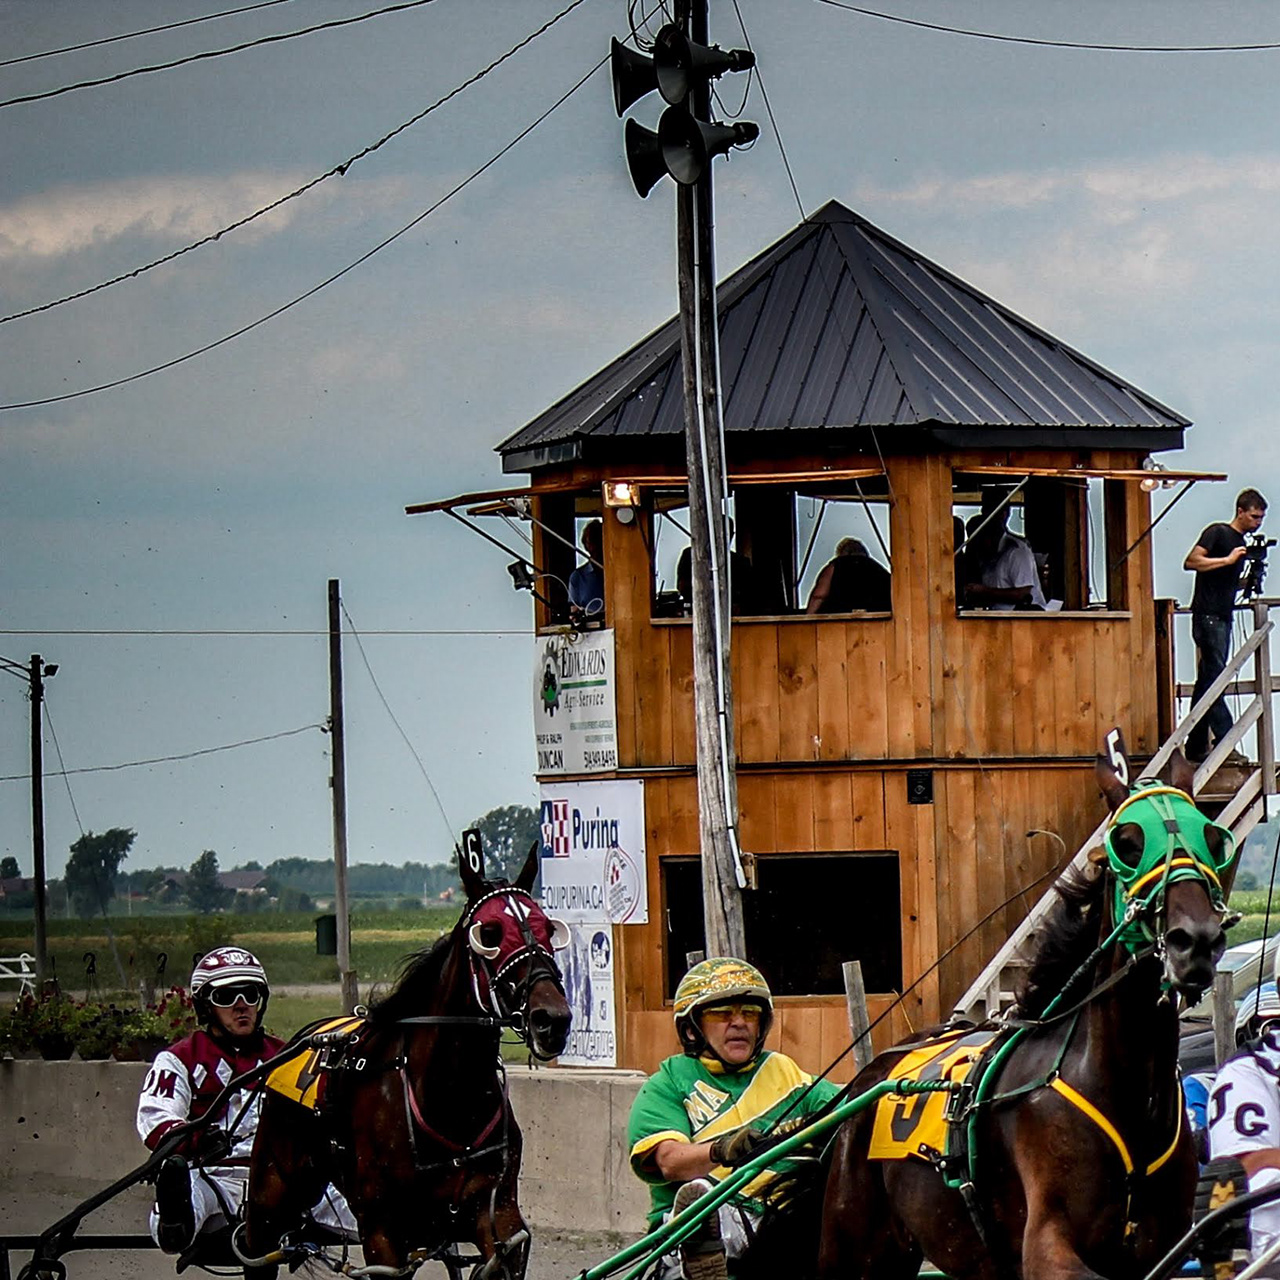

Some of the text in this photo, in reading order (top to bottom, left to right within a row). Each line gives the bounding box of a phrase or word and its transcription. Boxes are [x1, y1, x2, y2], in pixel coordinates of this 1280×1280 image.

[562, 647, 606, 678] EDWARDS
[538, 750, 563, 769] DUNCAN
[1107, 729, 1128, 787] 5
[572, 806, 618, 849] Purina
[467, 833, 480, 873] 6
[683, 1080, 730, 1132] MA
